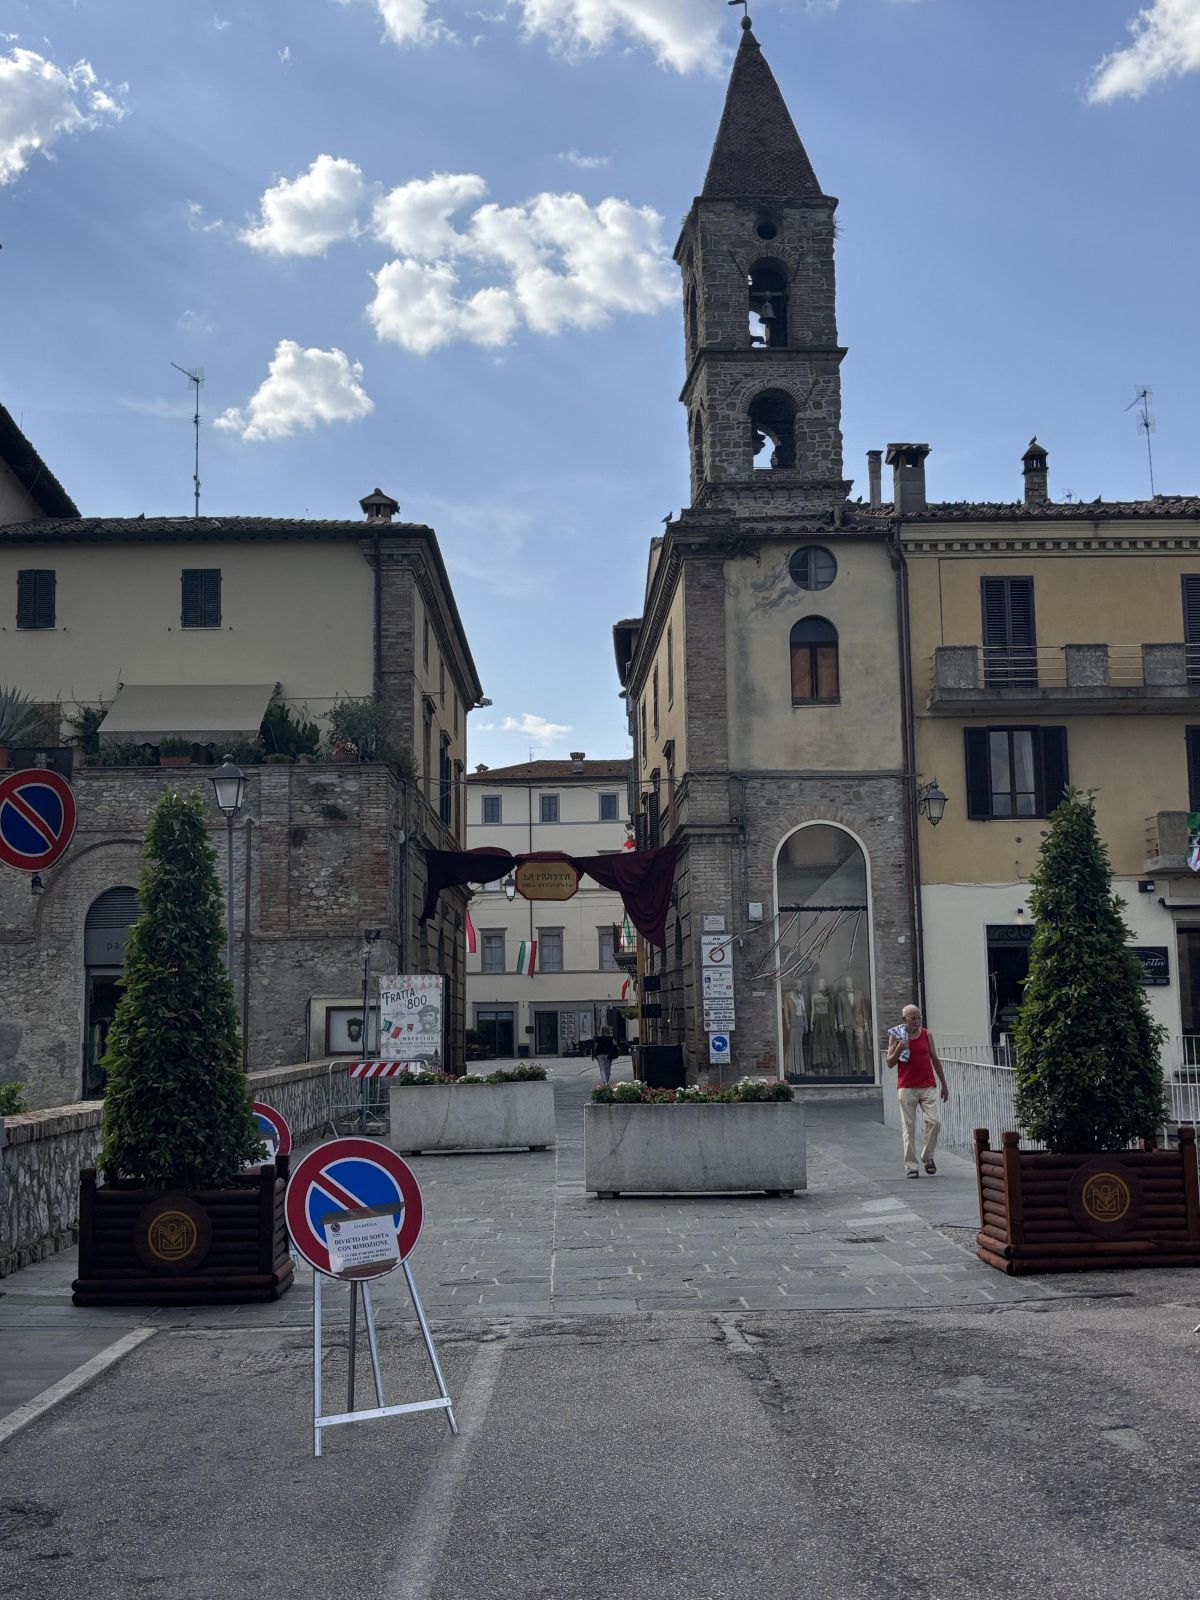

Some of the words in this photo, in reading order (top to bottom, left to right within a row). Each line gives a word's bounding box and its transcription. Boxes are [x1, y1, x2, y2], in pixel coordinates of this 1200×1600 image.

[522, 873, 534, 881] LA
[536, 873, 570, 881] FRATTA
[382, 988, 415, 1006] FRATTA
[334, 1236, 361, 1245] DIVIETO
[361, 1234, 369, 1242] DI
[369, 1232, 390, 1240] SOSTA
[337, 1244, 352, 1252] CON
[352, 1240, 388, 1250] RIMOZIONE
